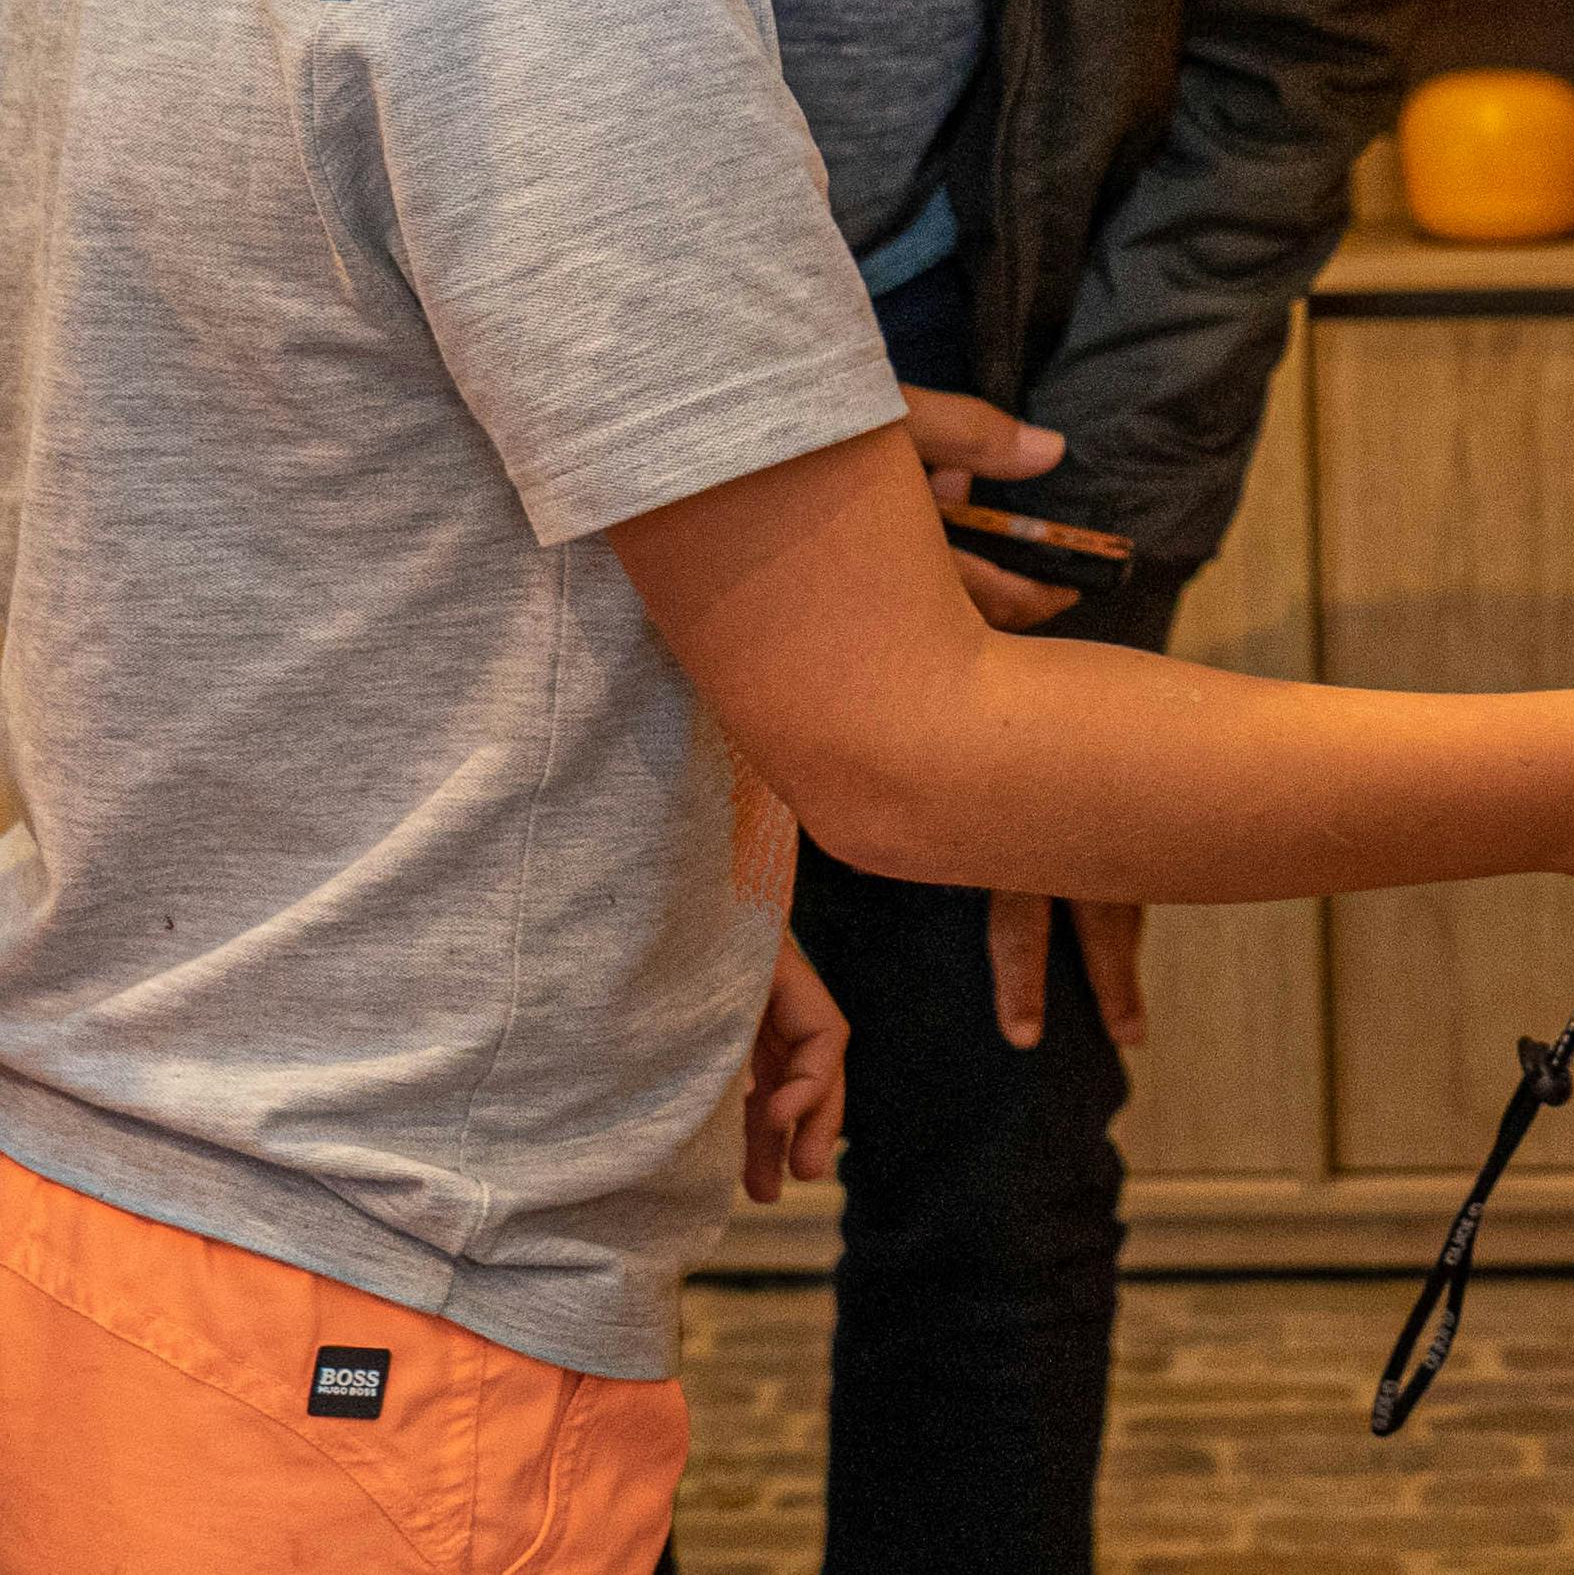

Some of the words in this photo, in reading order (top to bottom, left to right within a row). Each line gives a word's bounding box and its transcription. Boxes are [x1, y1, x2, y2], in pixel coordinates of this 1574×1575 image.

[319, 1367, 380, 1388] BOSS
[317, 1385, 348, 1395] HUGO
[348, 1387, 377, 1397] BOSS
